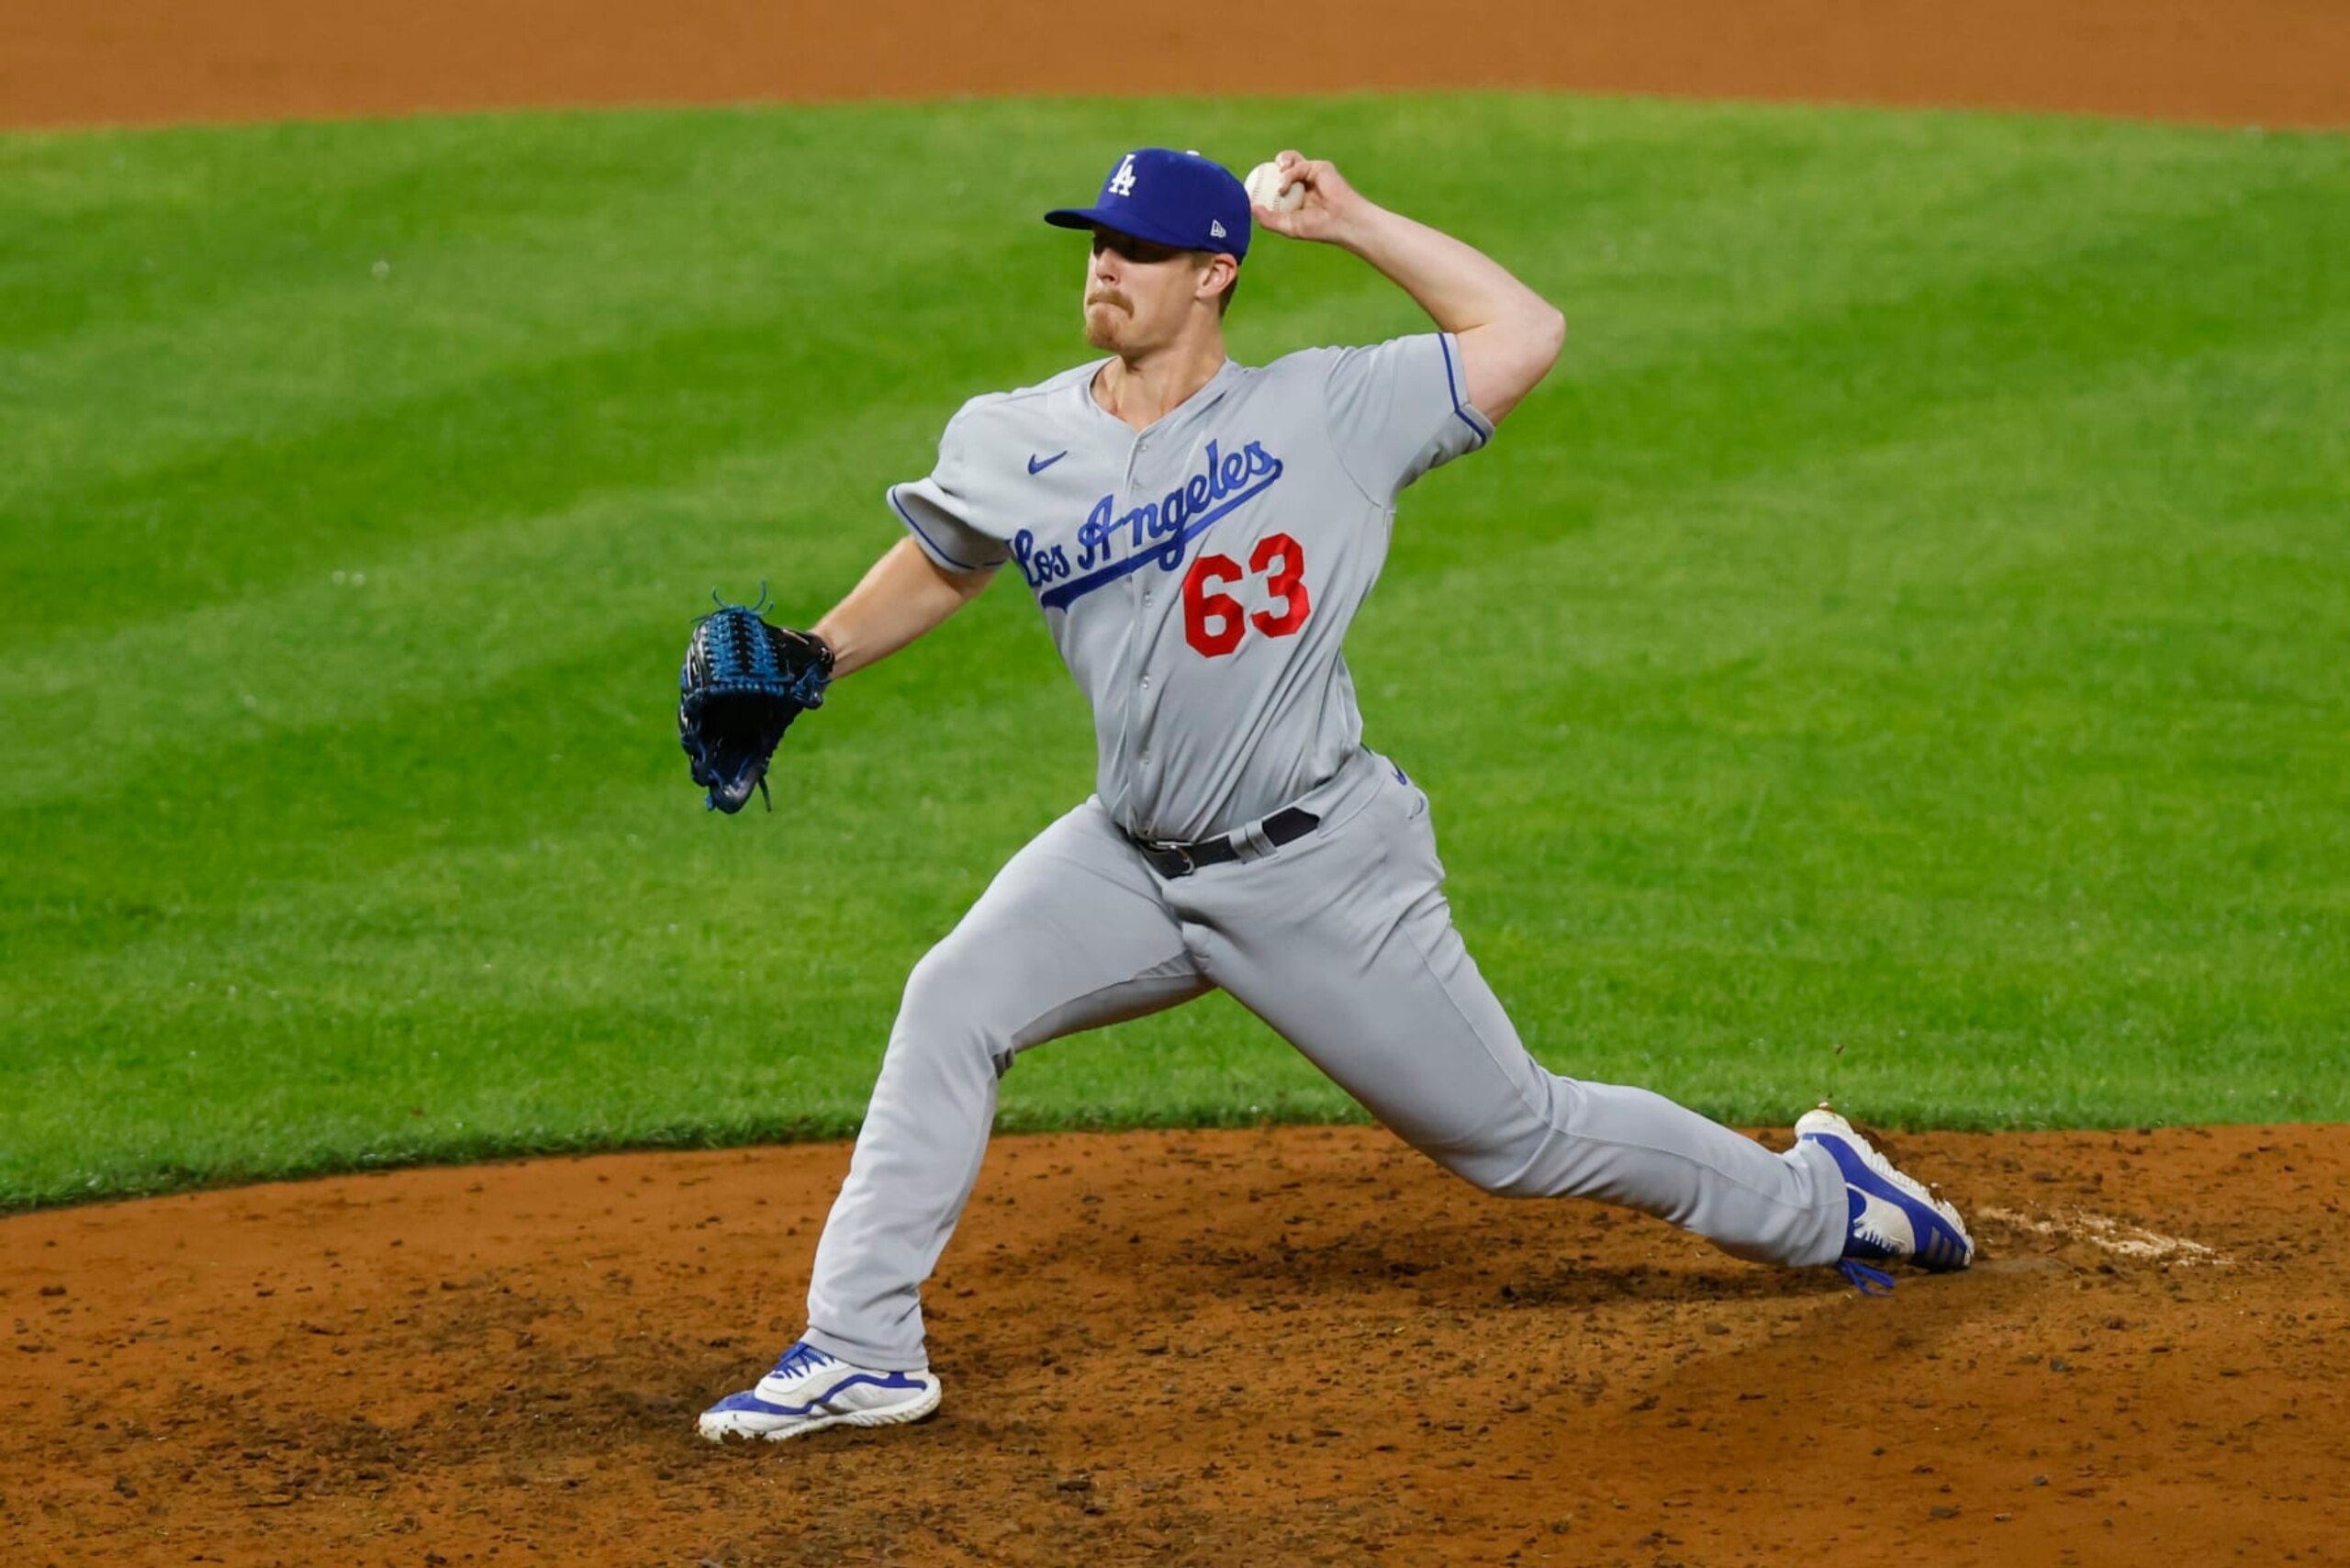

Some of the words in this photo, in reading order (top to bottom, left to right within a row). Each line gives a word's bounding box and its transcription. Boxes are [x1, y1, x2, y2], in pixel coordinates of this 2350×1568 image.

[1108, 153, 1136, 196] LA
[1006, 529, 1070, 587] Los
[1078, 438, 1283, 571] Angeles
[1182, 532, 1310, 658] 63
